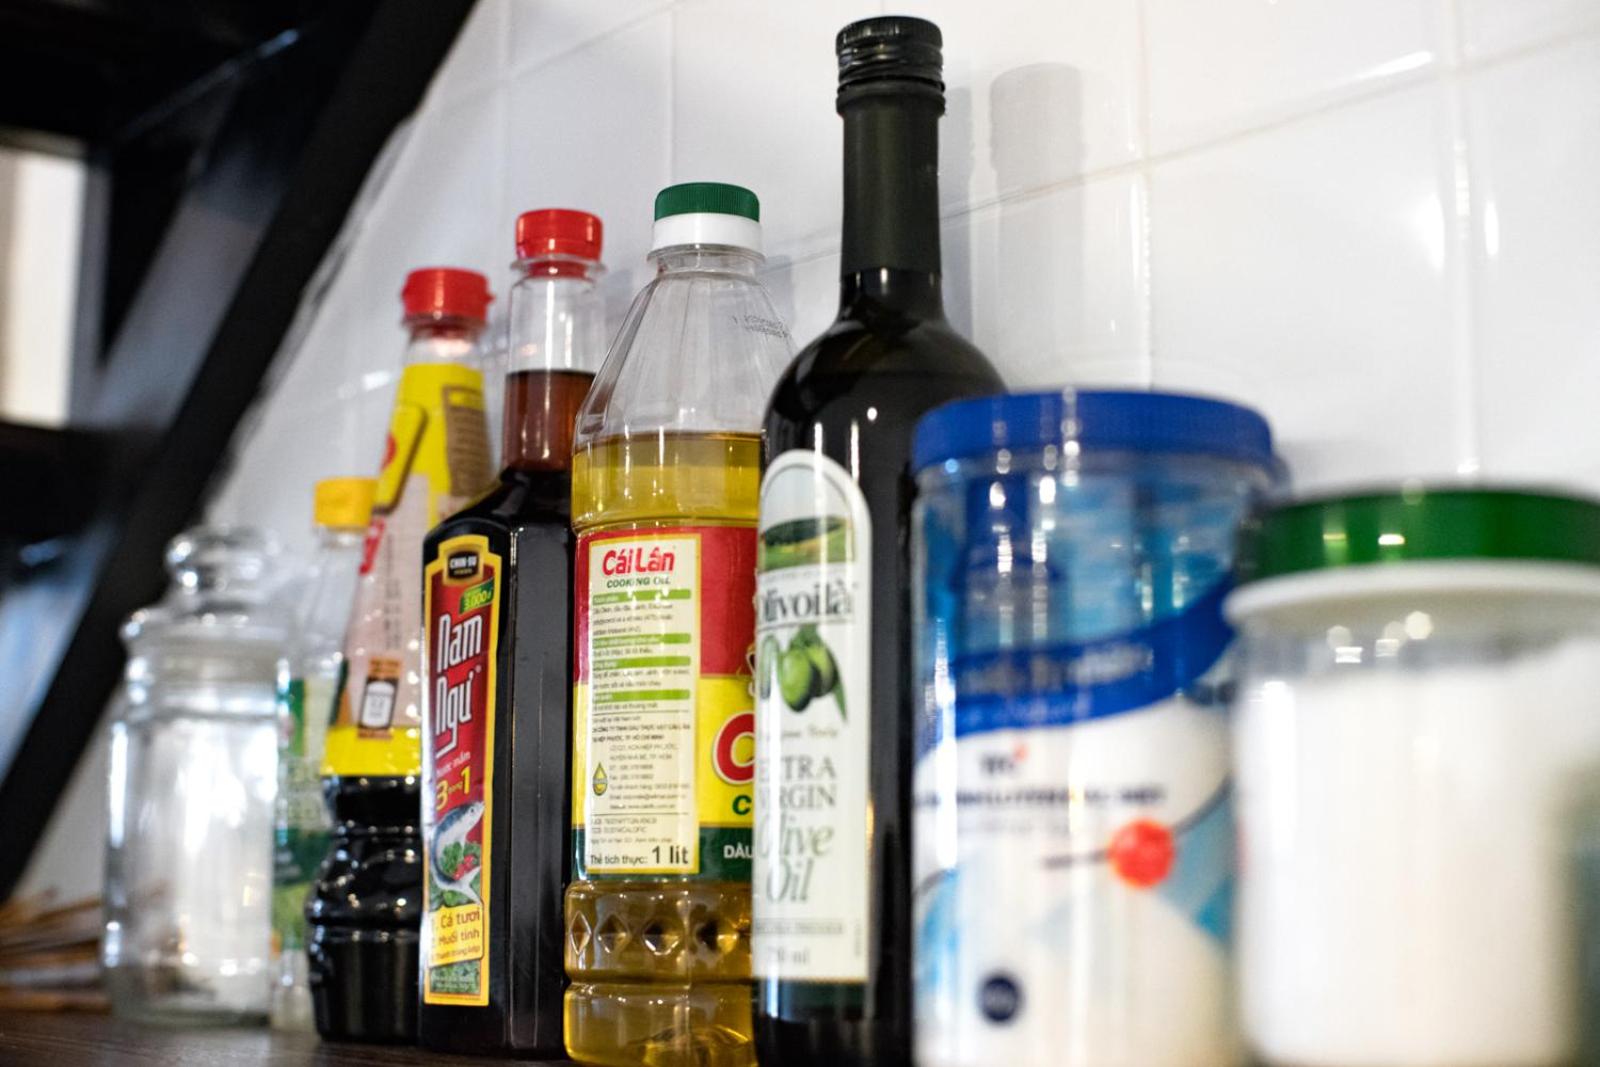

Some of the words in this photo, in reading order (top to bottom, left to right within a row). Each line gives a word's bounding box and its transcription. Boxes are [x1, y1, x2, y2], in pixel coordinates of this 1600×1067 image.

[758, 754, 837, 782] ETRA
[435, 780, 449, 811] 3
[461, 765, 471, 795] 1
[758, 783, 837, 811] VRGIN
[652, 845, 660, 864] 1
